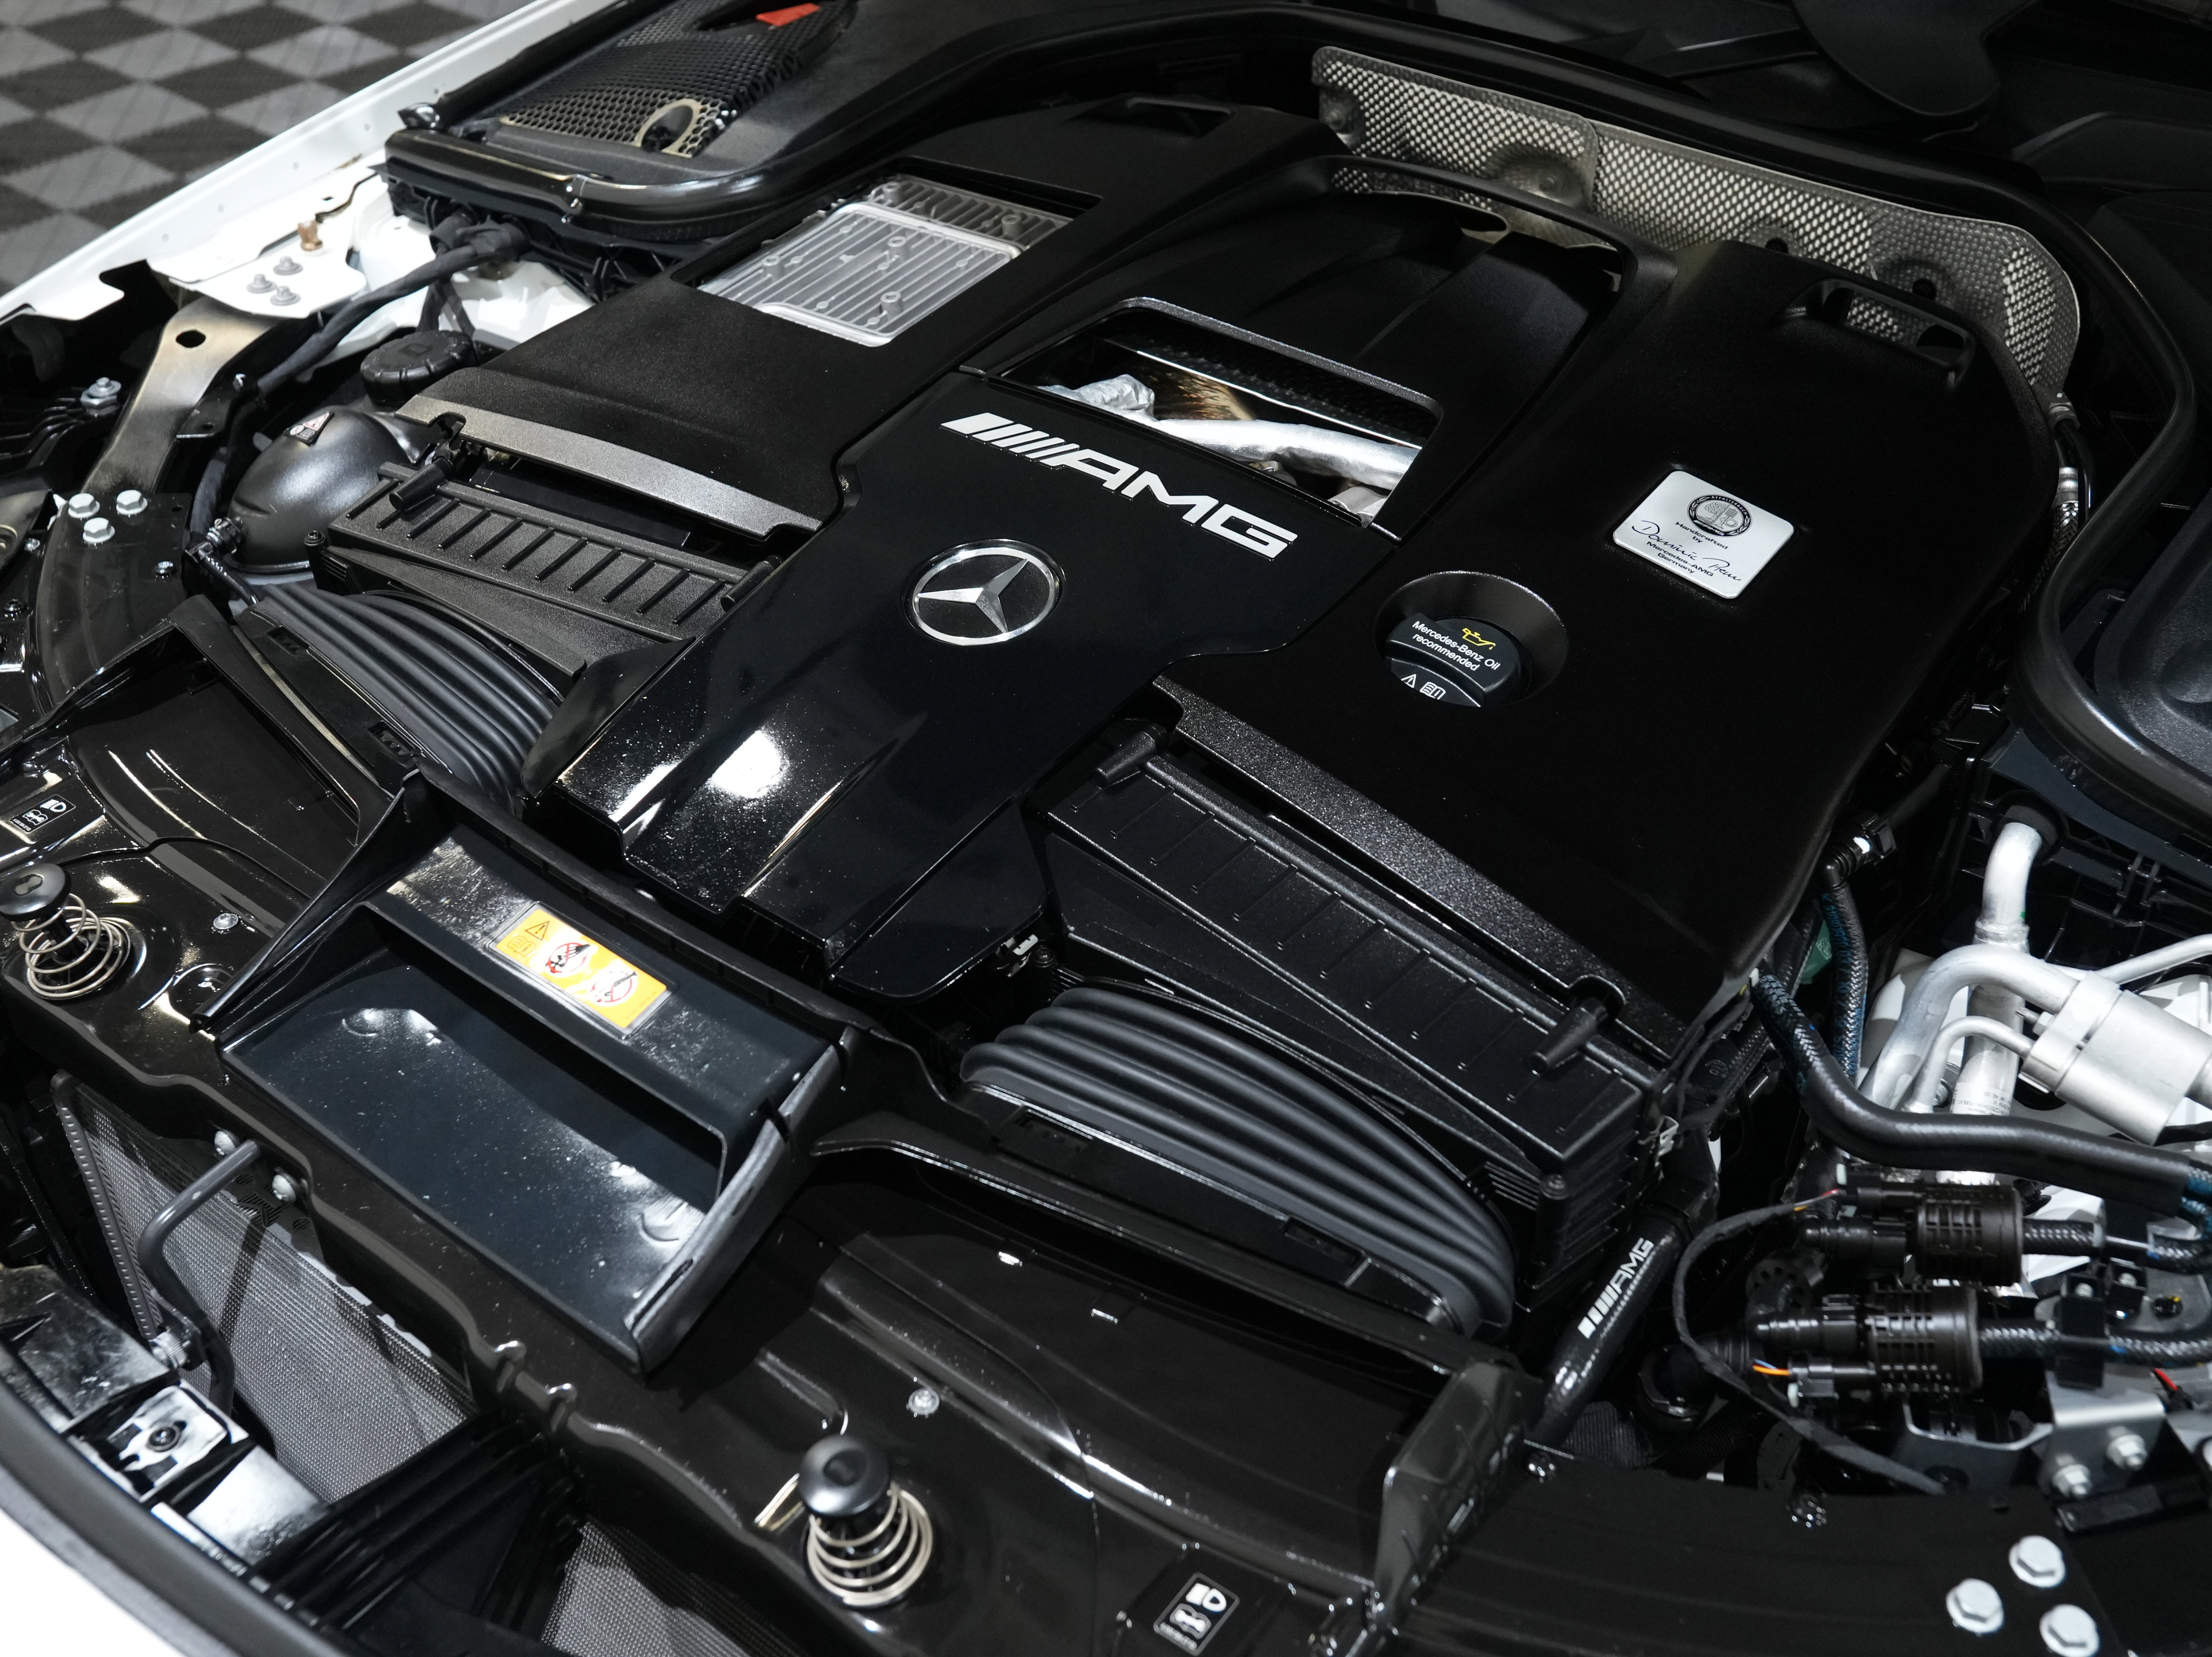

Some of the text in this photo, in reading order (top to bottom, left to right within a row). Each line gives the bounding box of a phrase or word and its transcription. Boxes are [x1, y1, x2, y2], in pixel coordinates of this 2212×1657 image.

[1039, 449, 1298, 559] AMG
[1711, 495, 1748, 515] AFFALTERBACH
[1675, 521, 1728, 550] Handcrafted
[1646, 541, 1714, 577] Mercedes-AMG
[1657, 552, 1695, 574] Germany
[1412, 621, 1501, 670] Mercedes-Benz Oil
[1412, 634, 1481, 671] recommended
